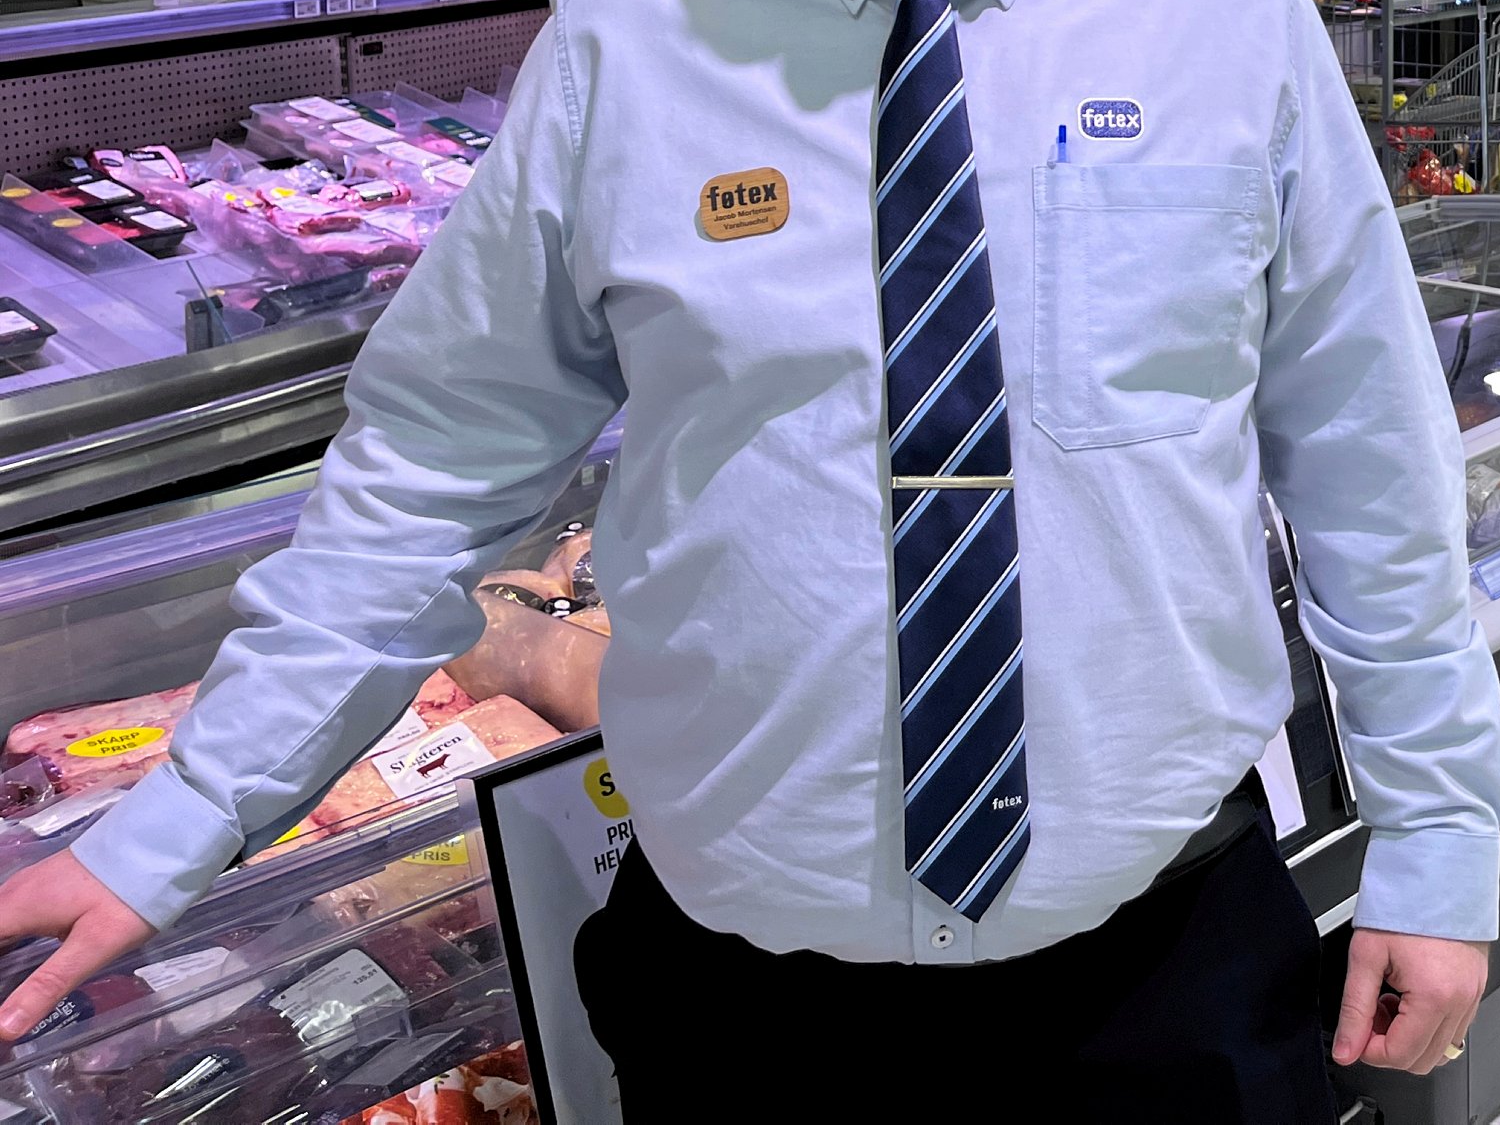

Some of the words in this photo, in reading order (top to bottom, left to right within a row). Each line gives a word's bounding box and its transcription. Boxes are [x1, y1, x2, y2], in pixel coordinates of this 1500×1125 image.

[1082, 108, 1140, 128] føtex
[706, 182, 778, 212] føtex
[86, 732, 140, 747] SKARP
[100, 742, 137, 754] PRIS
[599, 772, 616, 797] S
[606, 818, 634, 845] PRI
